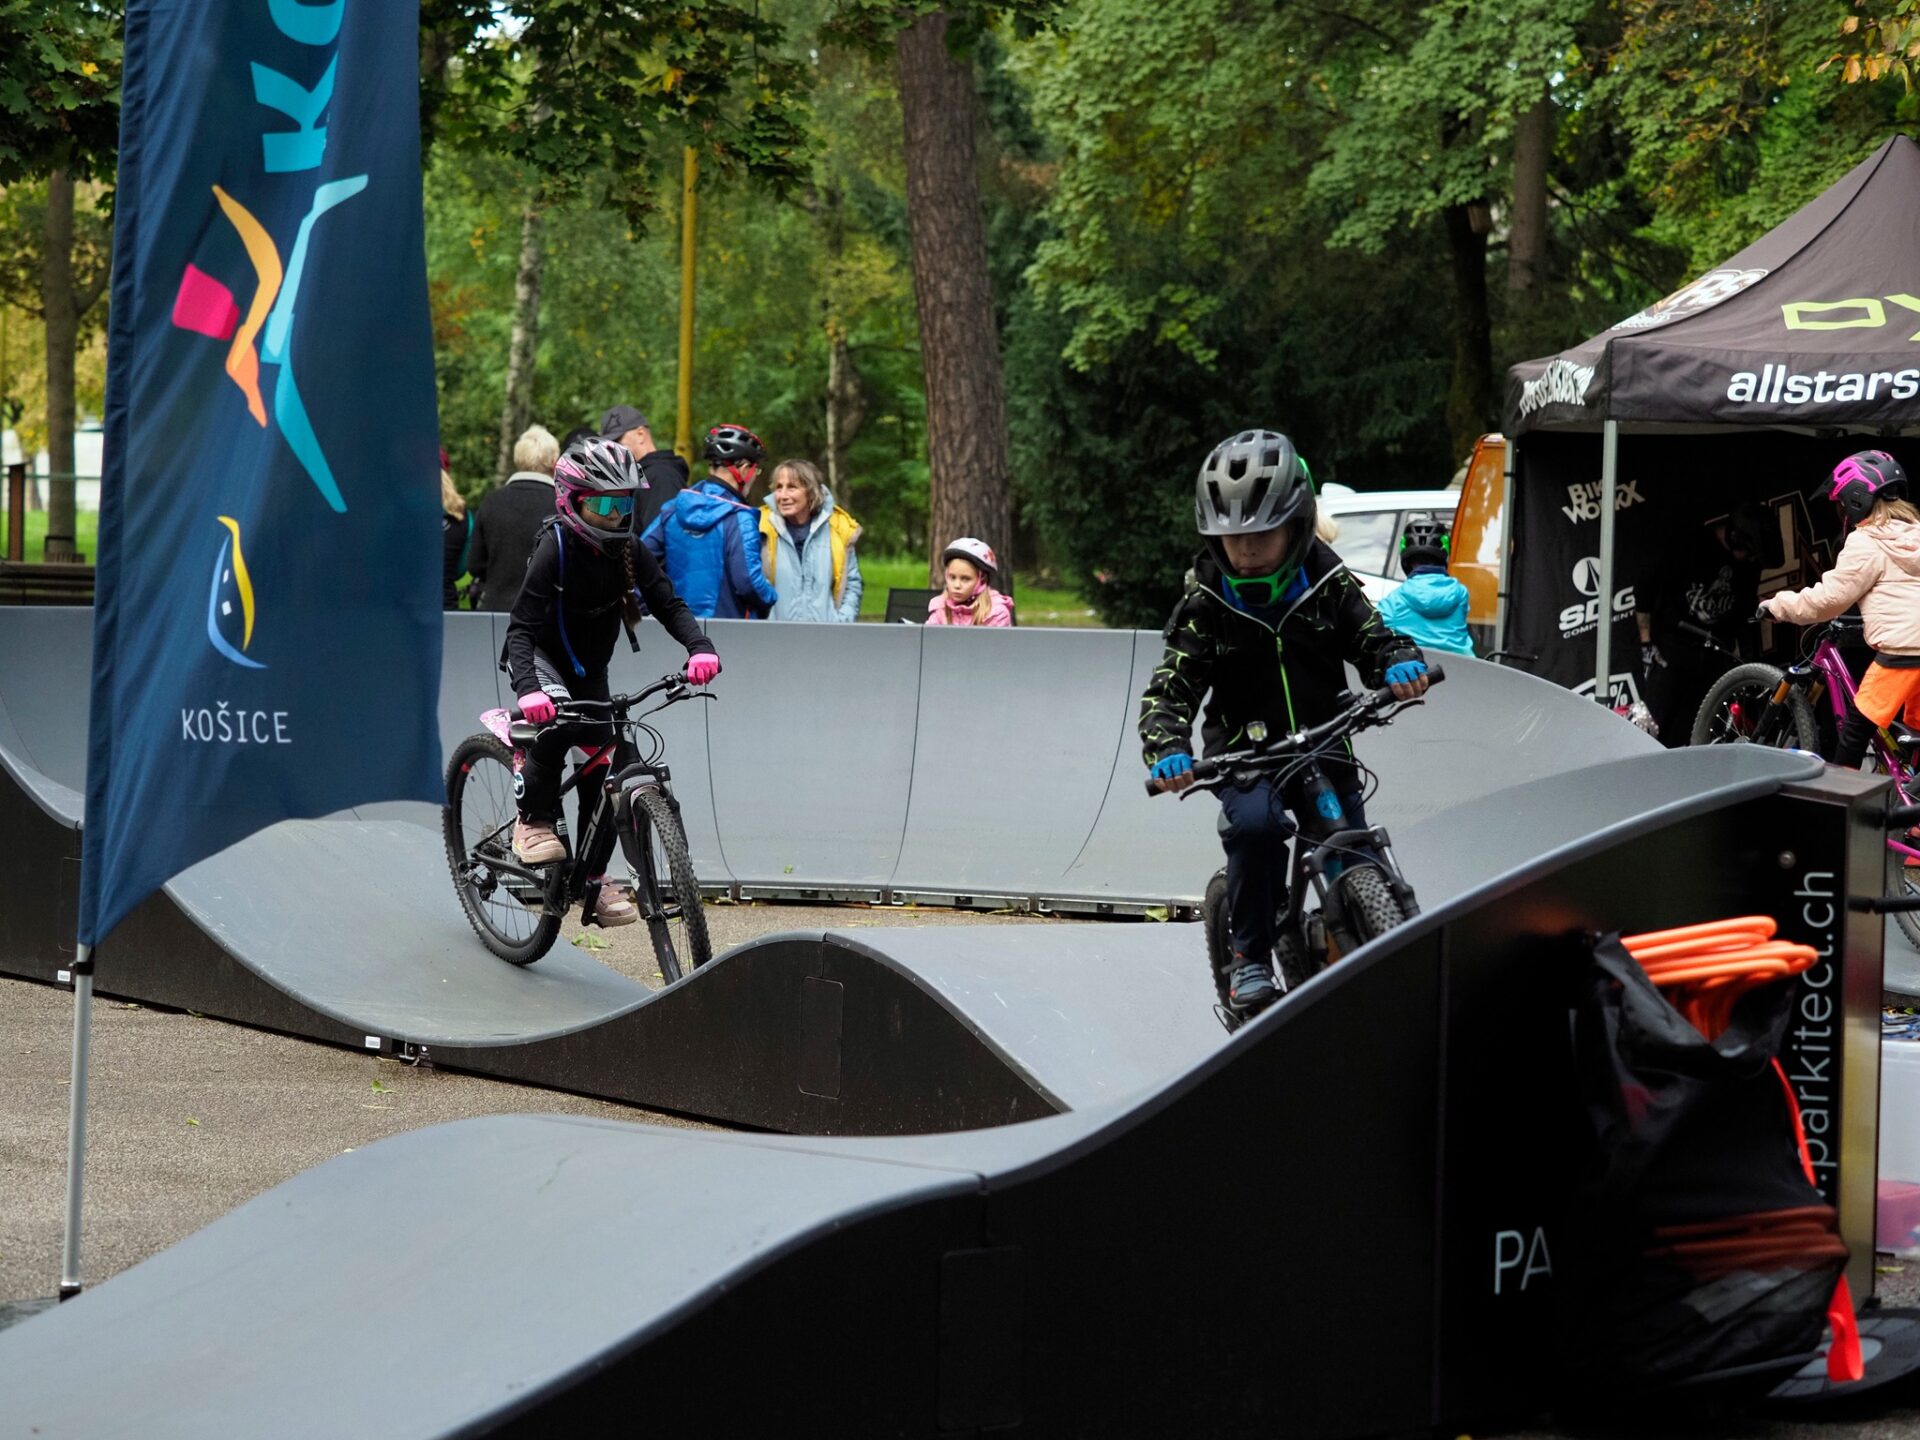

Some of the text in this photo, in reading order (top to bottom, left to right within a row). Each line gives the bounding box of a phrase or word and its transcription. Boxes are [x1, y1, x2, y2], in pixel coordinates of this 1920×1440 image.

[1726, 363, 1920, 404] allstars
[1558, 585, 1637, 631] SDG
[181, 700, 292, 743] KOŠICE
